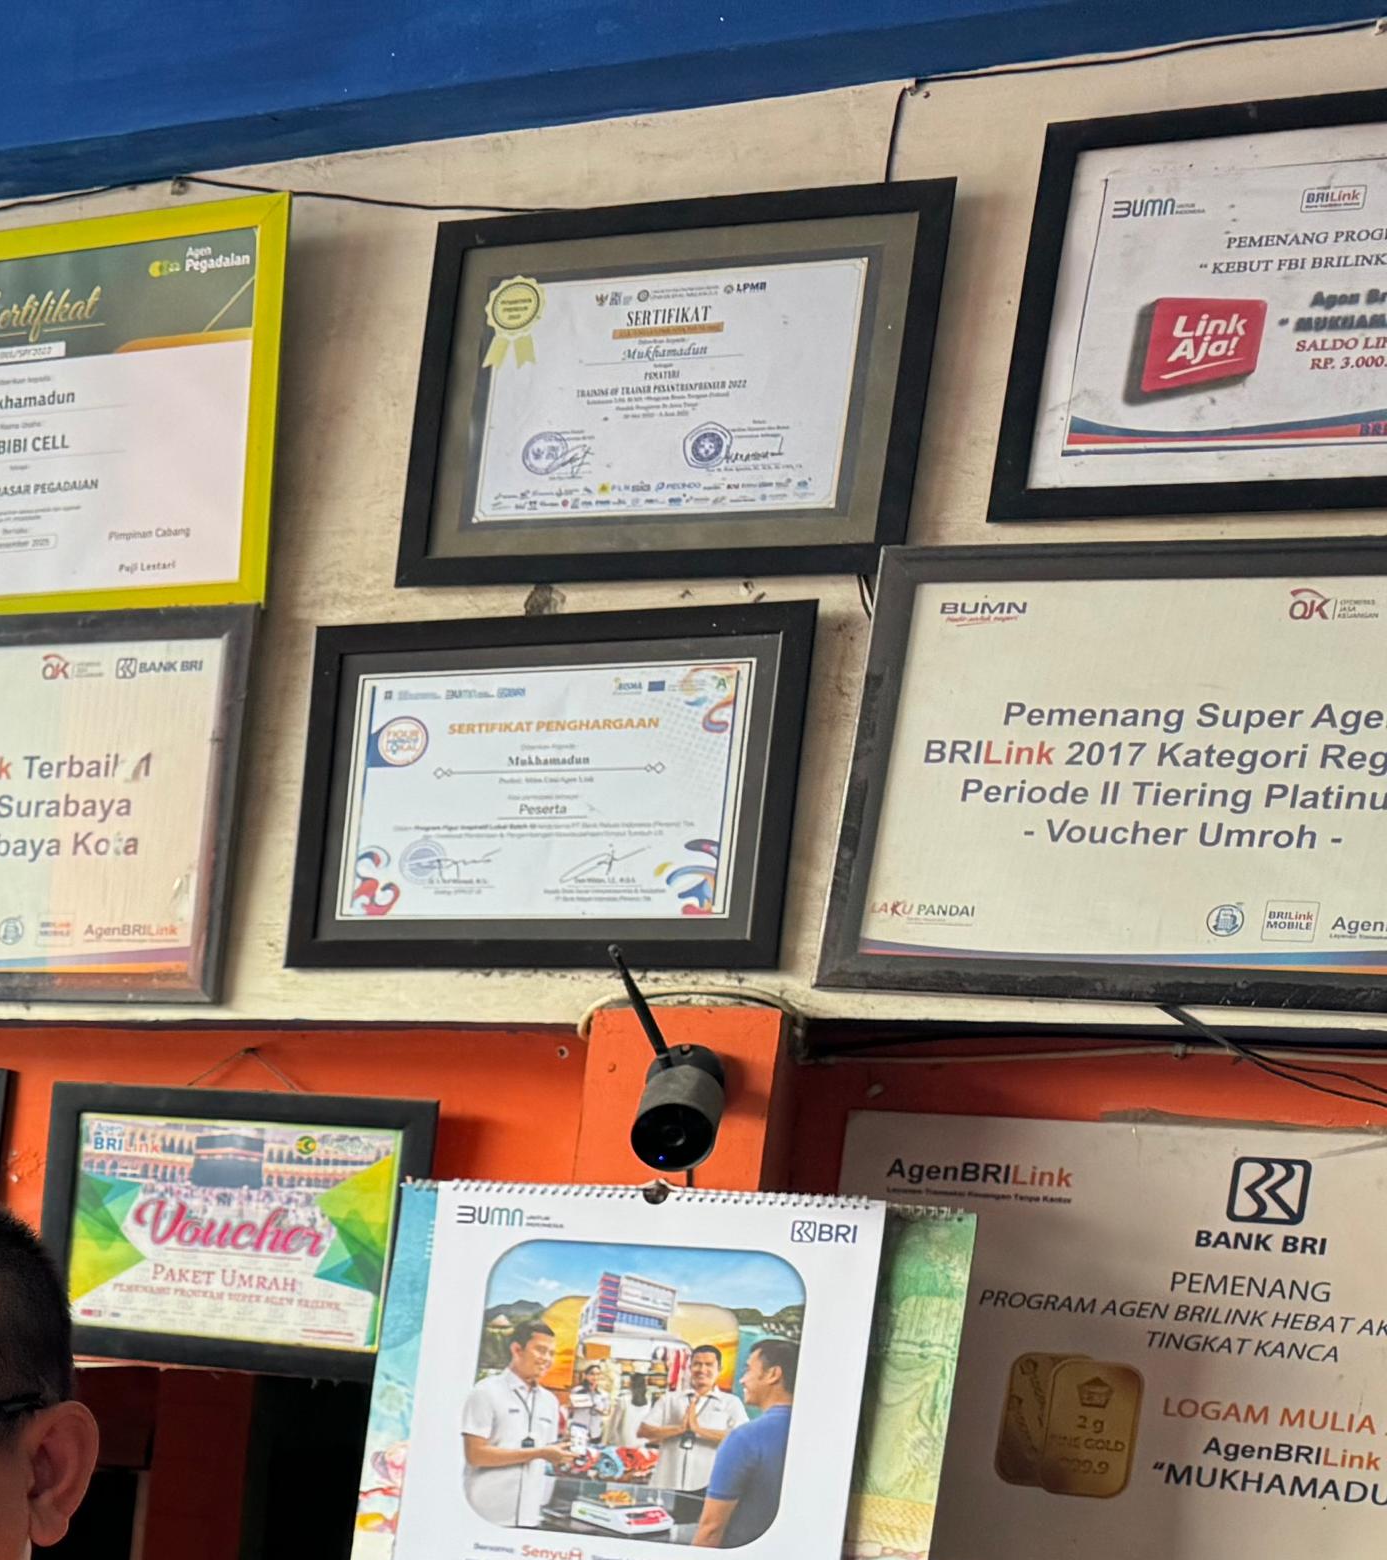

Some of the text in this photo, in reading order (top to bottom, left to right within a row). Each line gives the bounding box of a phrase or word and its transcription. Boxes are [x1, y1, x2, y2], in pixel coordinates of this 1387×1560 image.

[1306, 190, 1360, 204] BRILink
[1227, 232, 1328, 248] PEMENANG
[186, 246, 211, 258] Agen
[185, 253, 250, 271] Pegadaian
[1211, 257, 1305, 274] KEBUT FBI
[627, 306, 711, 326] SERTIFIKAT
[1174, 314, 1248, 338] Link
[622, 343, 708, 361] Mukhamadun
[1167, 336, 1241, 364] Aja!
[1296, 338, 1359, 351] SALDO
[32, 435, 69, 452] CELL
[34, 479, 98, 495] PEGADAIAN
[940, 602, 1027, 615] BUMN
[139, 660, 203, 673] BANK BRI
[448, 718, 659, 735] SERTIFIKAT PENGHARGAAN
[1003, 702, 1303, 734] Pemenang Super
[507, 755, 590, 766] Mukhamadun
[925, 740, 1306, 776] BRILink 2017 Kategori
[961, 778, 1252, 813] Periode II Tiering
[519, 803, 567, 816] Peserta
[1046, 820, 1317, 849] Voucher Umroh
[917, 904, 975, 917] PANDAI
[1268, 911, 1314, 921] BRILink
[1266, 921, 1312, 931] MOBILE
[887, 1158, 1072, 1187] AgenBRILink
[456, 1205, 523, 1227] BUMN
[133, 1199, 325, 1257] Voucher
[819, 1224, 857, 1244] BRI
[1195, 1230, 1327, 1255] BANK BRI
[1170, 1272, 1331, 1303] PEMENANG
[978, 1289, 1355, 1335] PROGRAM AGEN BRILINK HEBAT
[1146, 1331, 1339, 1363] TINGKAT KANCA
[1163, 1398, 1375, 1435] LOGAM MULIA
[1203, 1437, 1380, 1471] AgenBRILink
